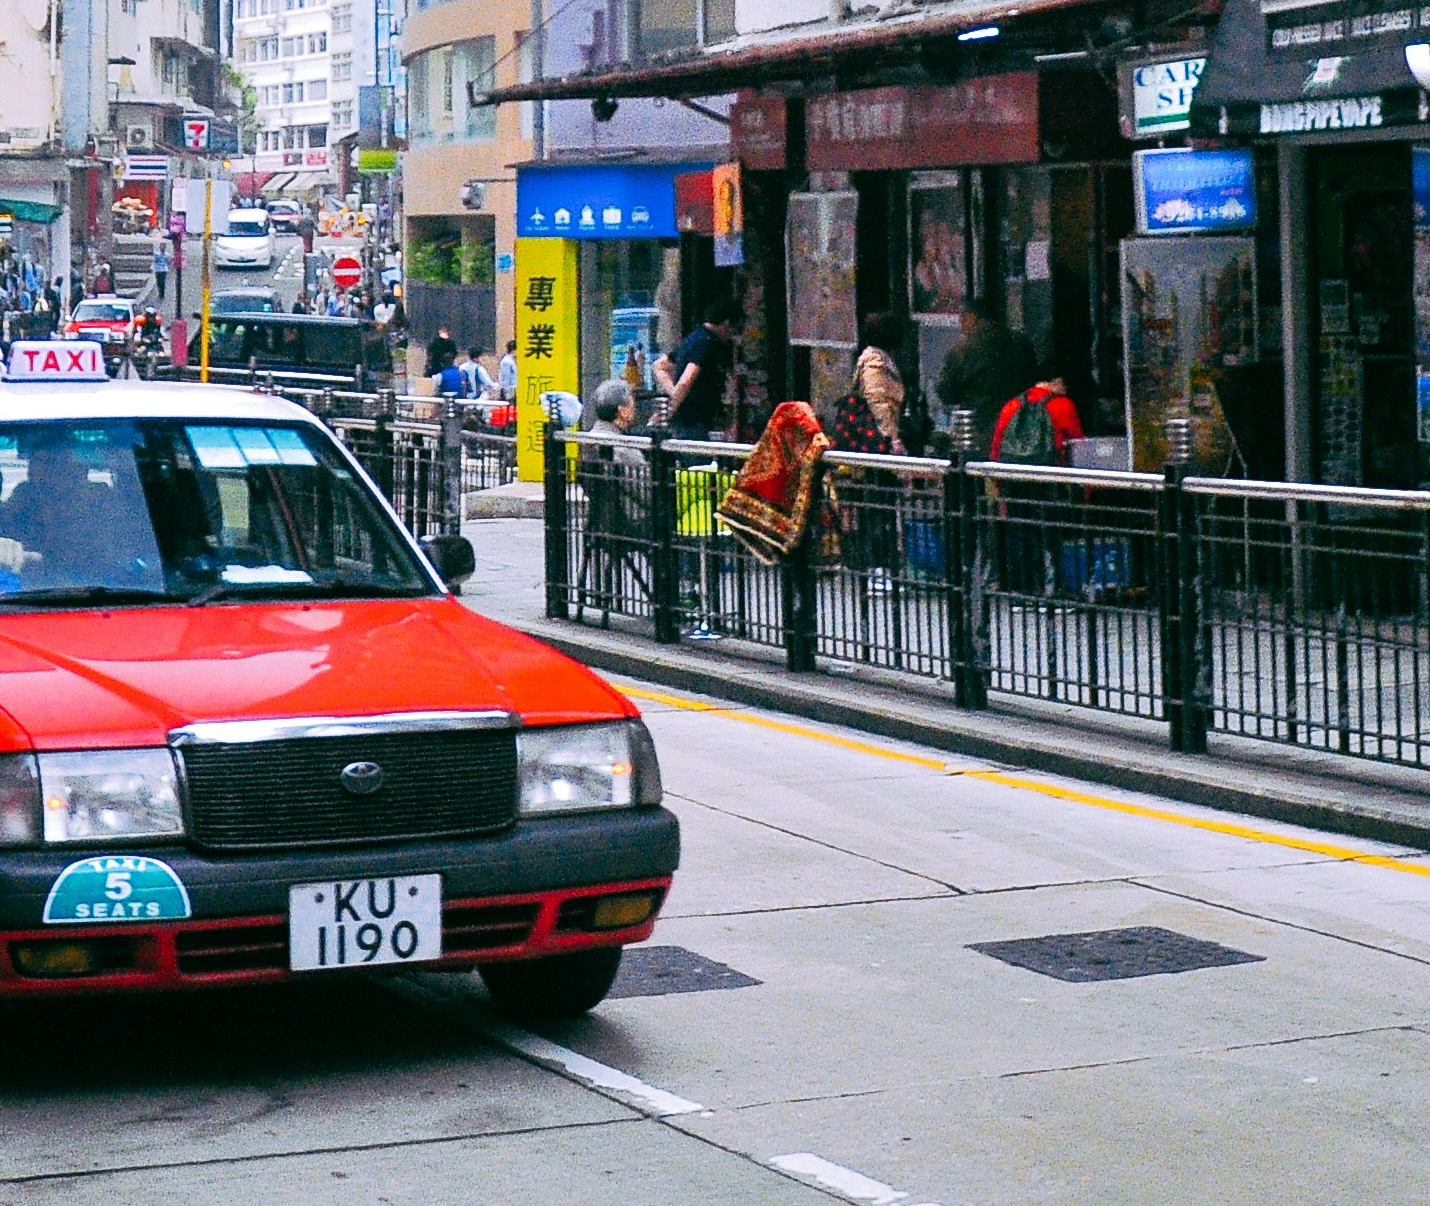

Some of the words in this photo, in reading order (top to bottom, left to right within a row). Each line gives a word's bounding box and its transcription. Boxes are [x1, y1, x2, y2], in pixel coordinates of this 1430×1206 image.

[22, 350, 96, 372] TAXI
[88, 859, 147, 872] TAXI
[104, 871, 133, 900] 5
[74, 901, 160, 918] SEATS
[334, 878, 396, 923] KU
[318, 920, 419, 966] 1190
